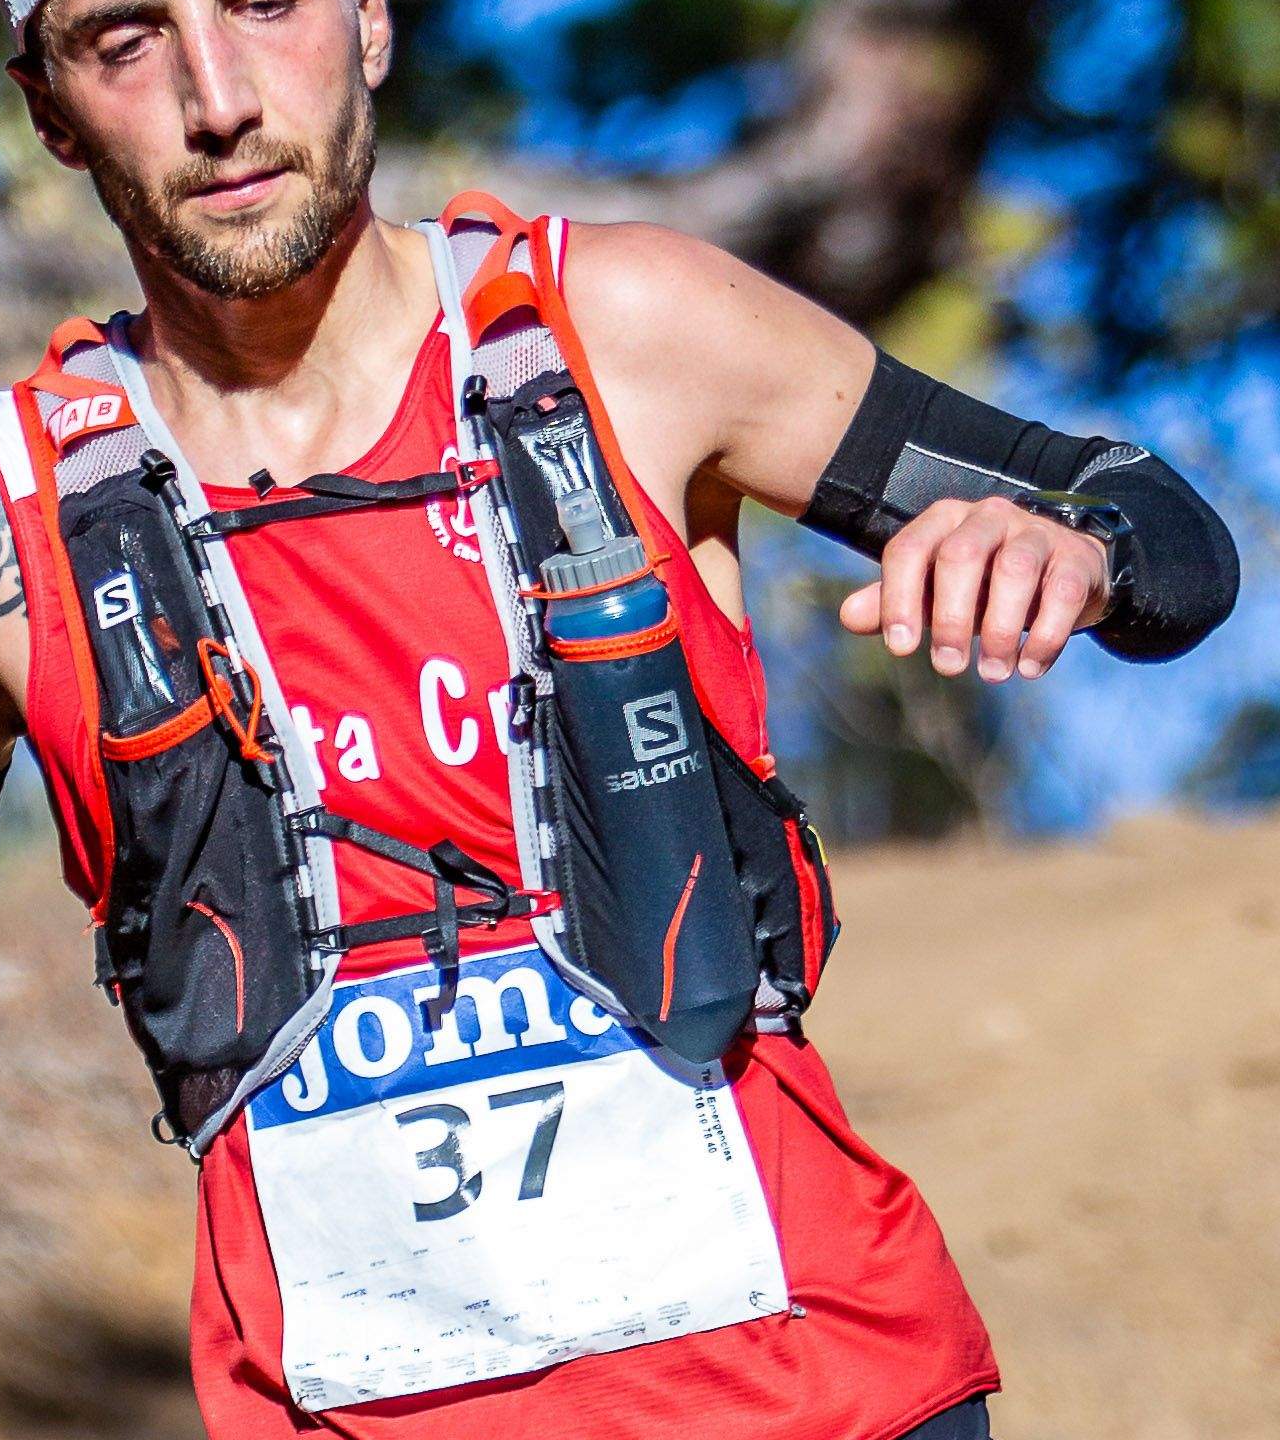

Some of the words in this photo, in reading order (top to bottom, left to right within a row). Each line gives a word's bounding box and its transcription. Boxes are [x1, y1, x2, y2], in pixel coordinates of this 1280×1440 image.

[66, 408, 78, 426] A
[97, 401, 112, 416] B
[395, 1080, 565, 1223] 37
[706, 1096, 732, 1161] Emergencias
